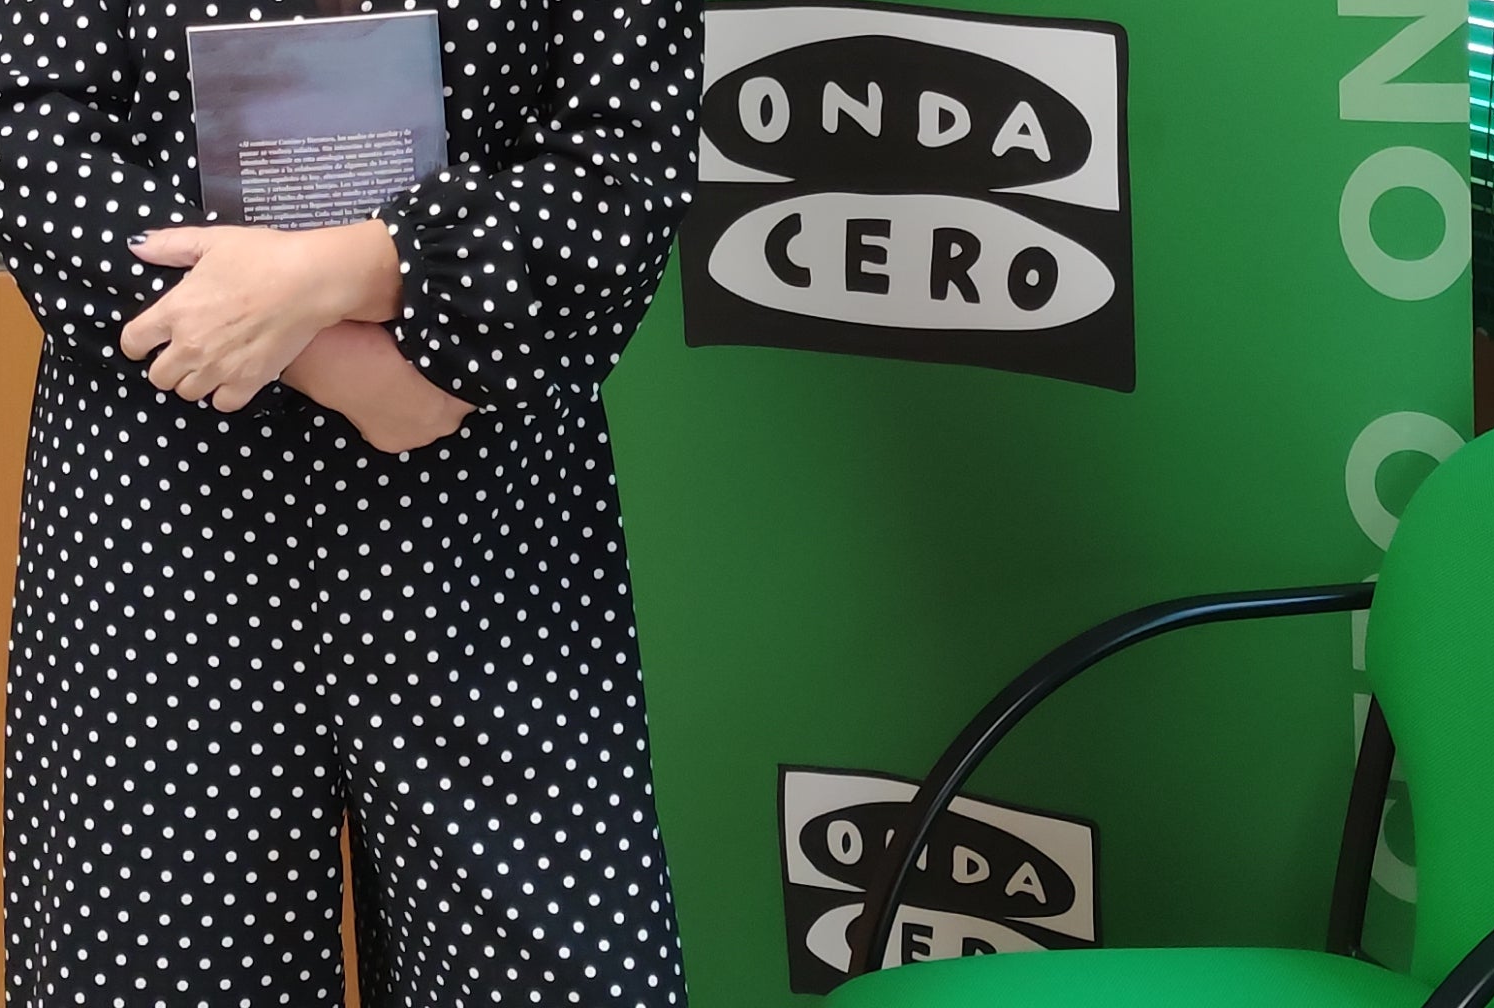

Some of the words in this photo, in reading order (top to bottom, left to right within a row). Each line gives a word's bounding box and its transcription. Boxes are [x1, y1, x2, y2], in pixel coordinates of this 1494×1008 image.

[738, 76, 1051, 162] ONDA
[764, 212, 1059, 312] CERO
[826, 819, 1047, 904] ODA
